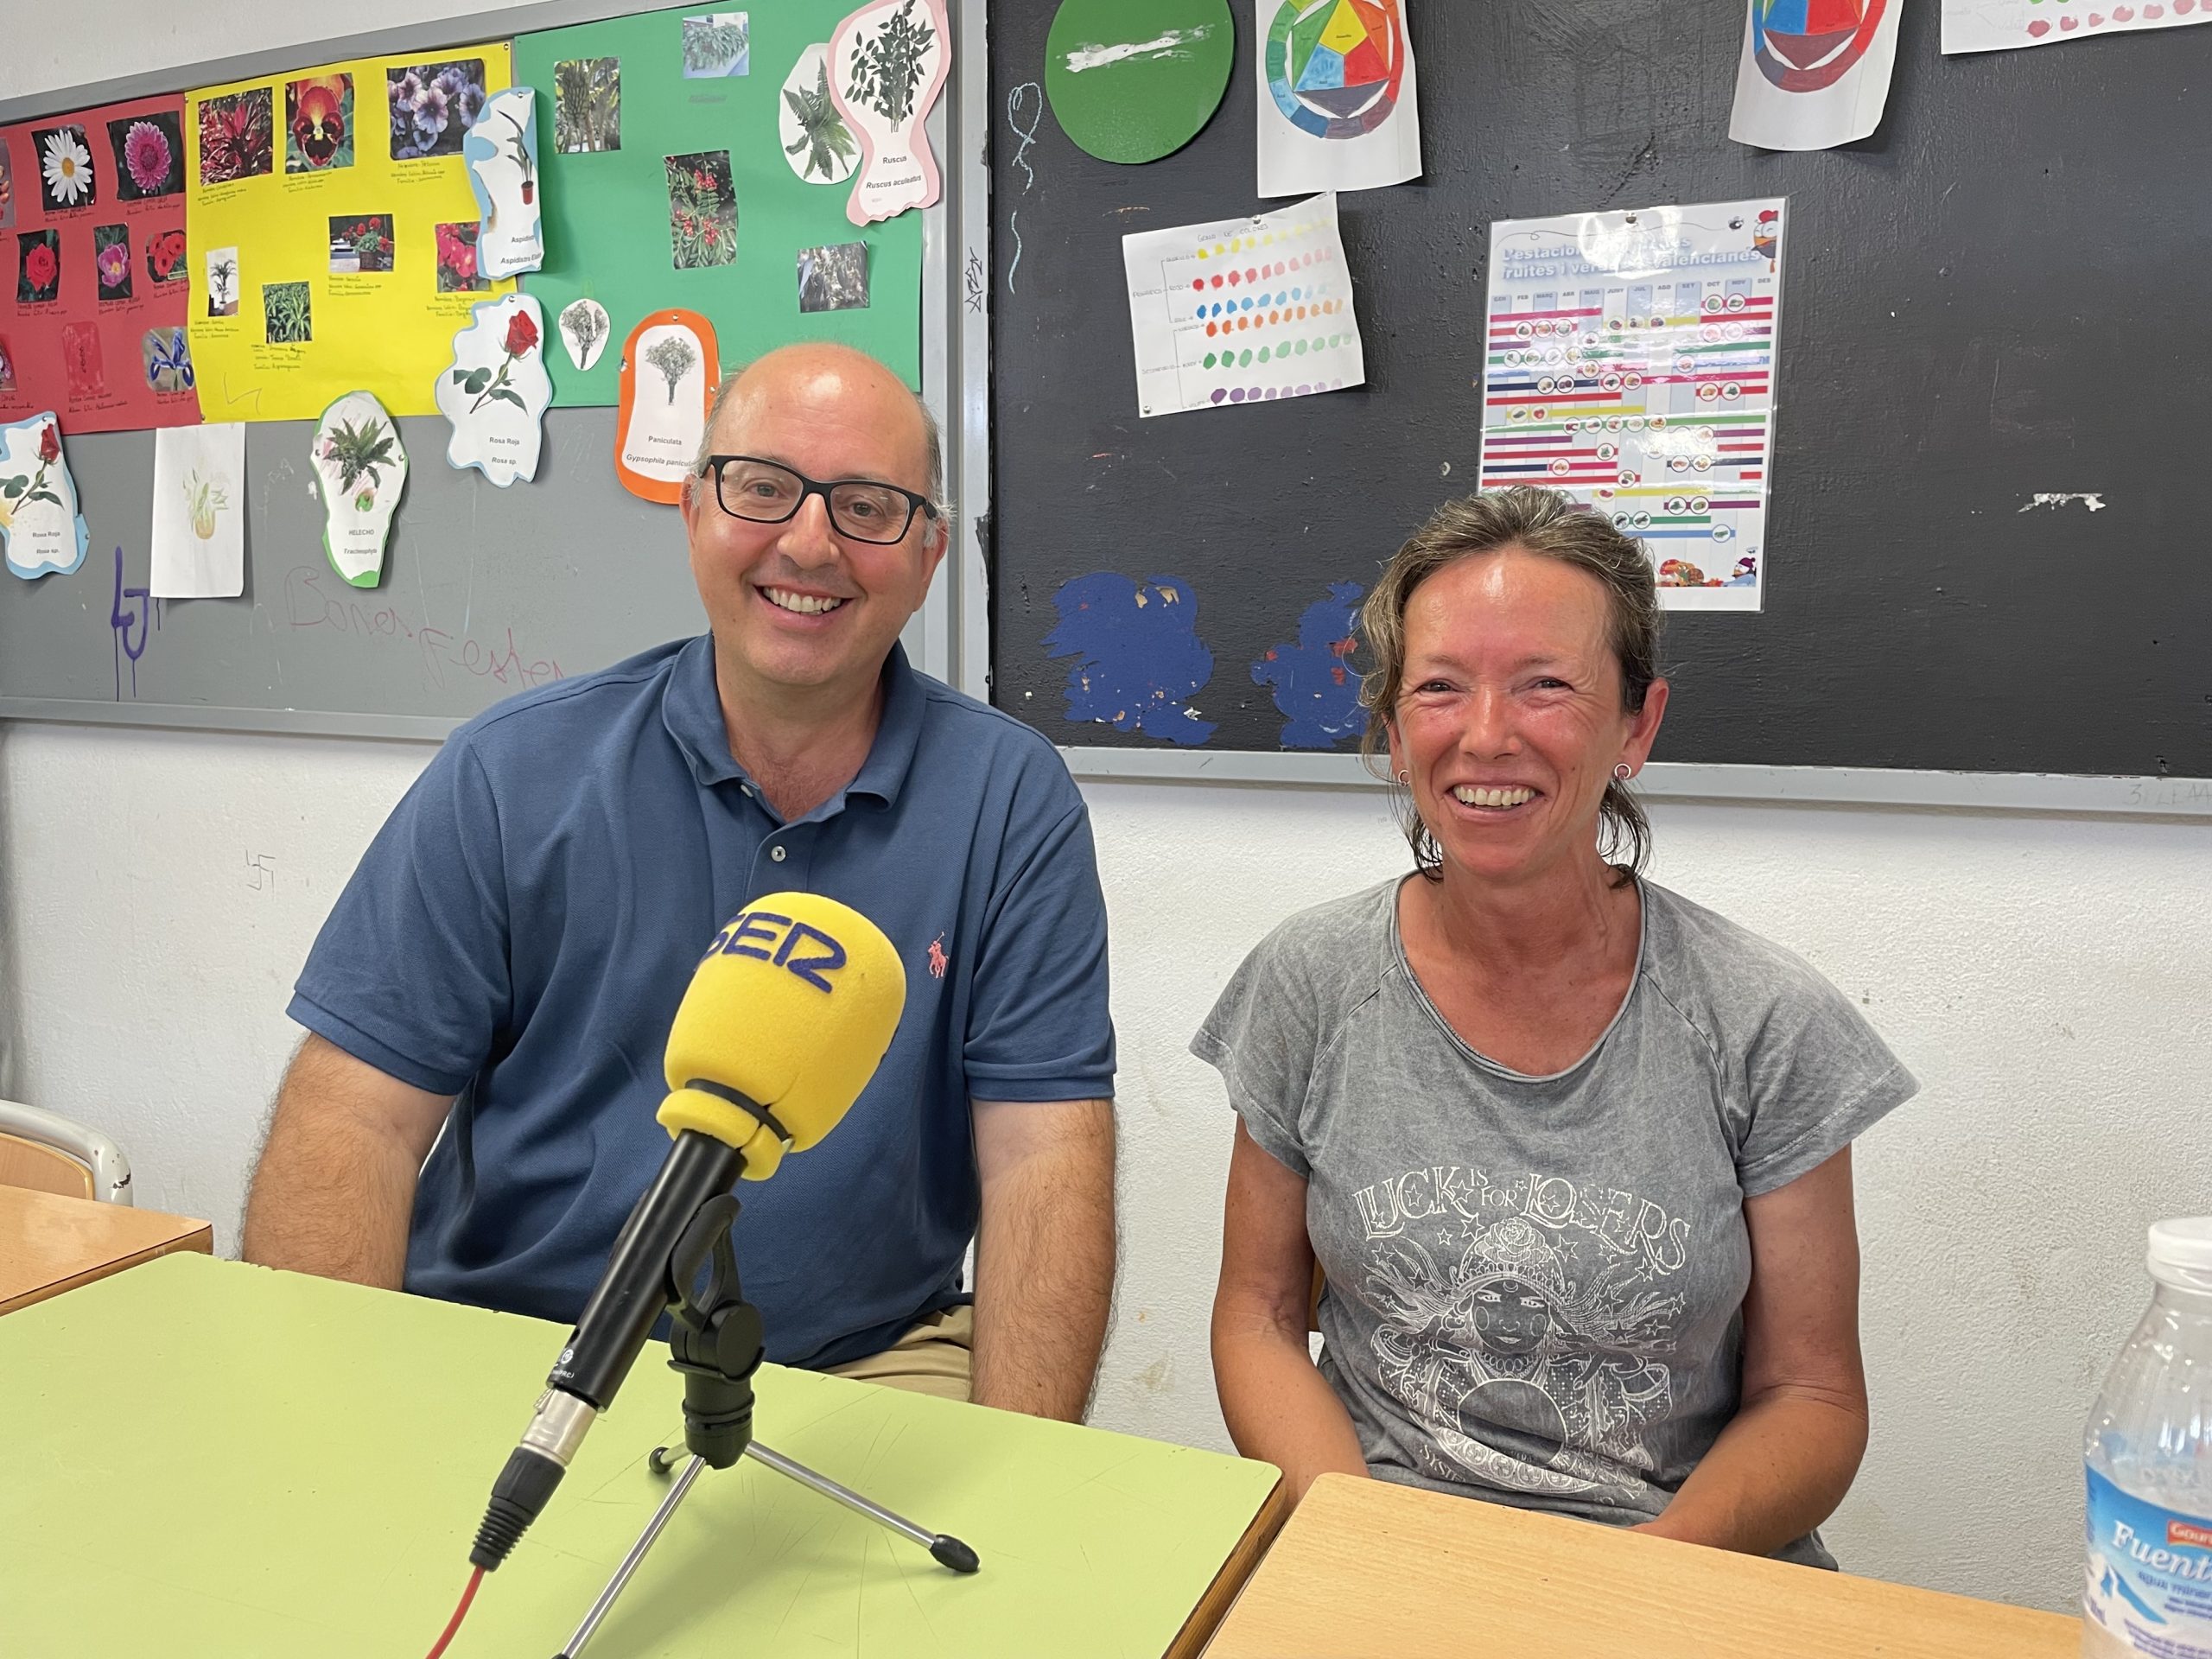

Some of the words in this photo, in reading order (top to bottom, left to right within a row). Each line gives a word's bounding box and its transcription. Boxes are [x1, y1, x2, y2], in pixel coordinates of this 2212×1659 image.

[882, 156, 907, 164] Ruscus
[866, 181, 893, 189] Ruscus
[506, 437, 520, 447] Roja
[647, 435, 683, 446] Paniculata
[626, 454, 665, 465] Gypsophila
[665, 459, 692, 467] panicul
[694, 912, 847, 994] SER
[1470, 1168, 1490, 1186] IS
[1353, 1166, 1480, 1241] LUCK
[1480, 1185, 1521, 1211] FOR
[1520, 1173, 1692, 1276] LOVERS
[1420, 1444, 1466, 1483] SYSTE
